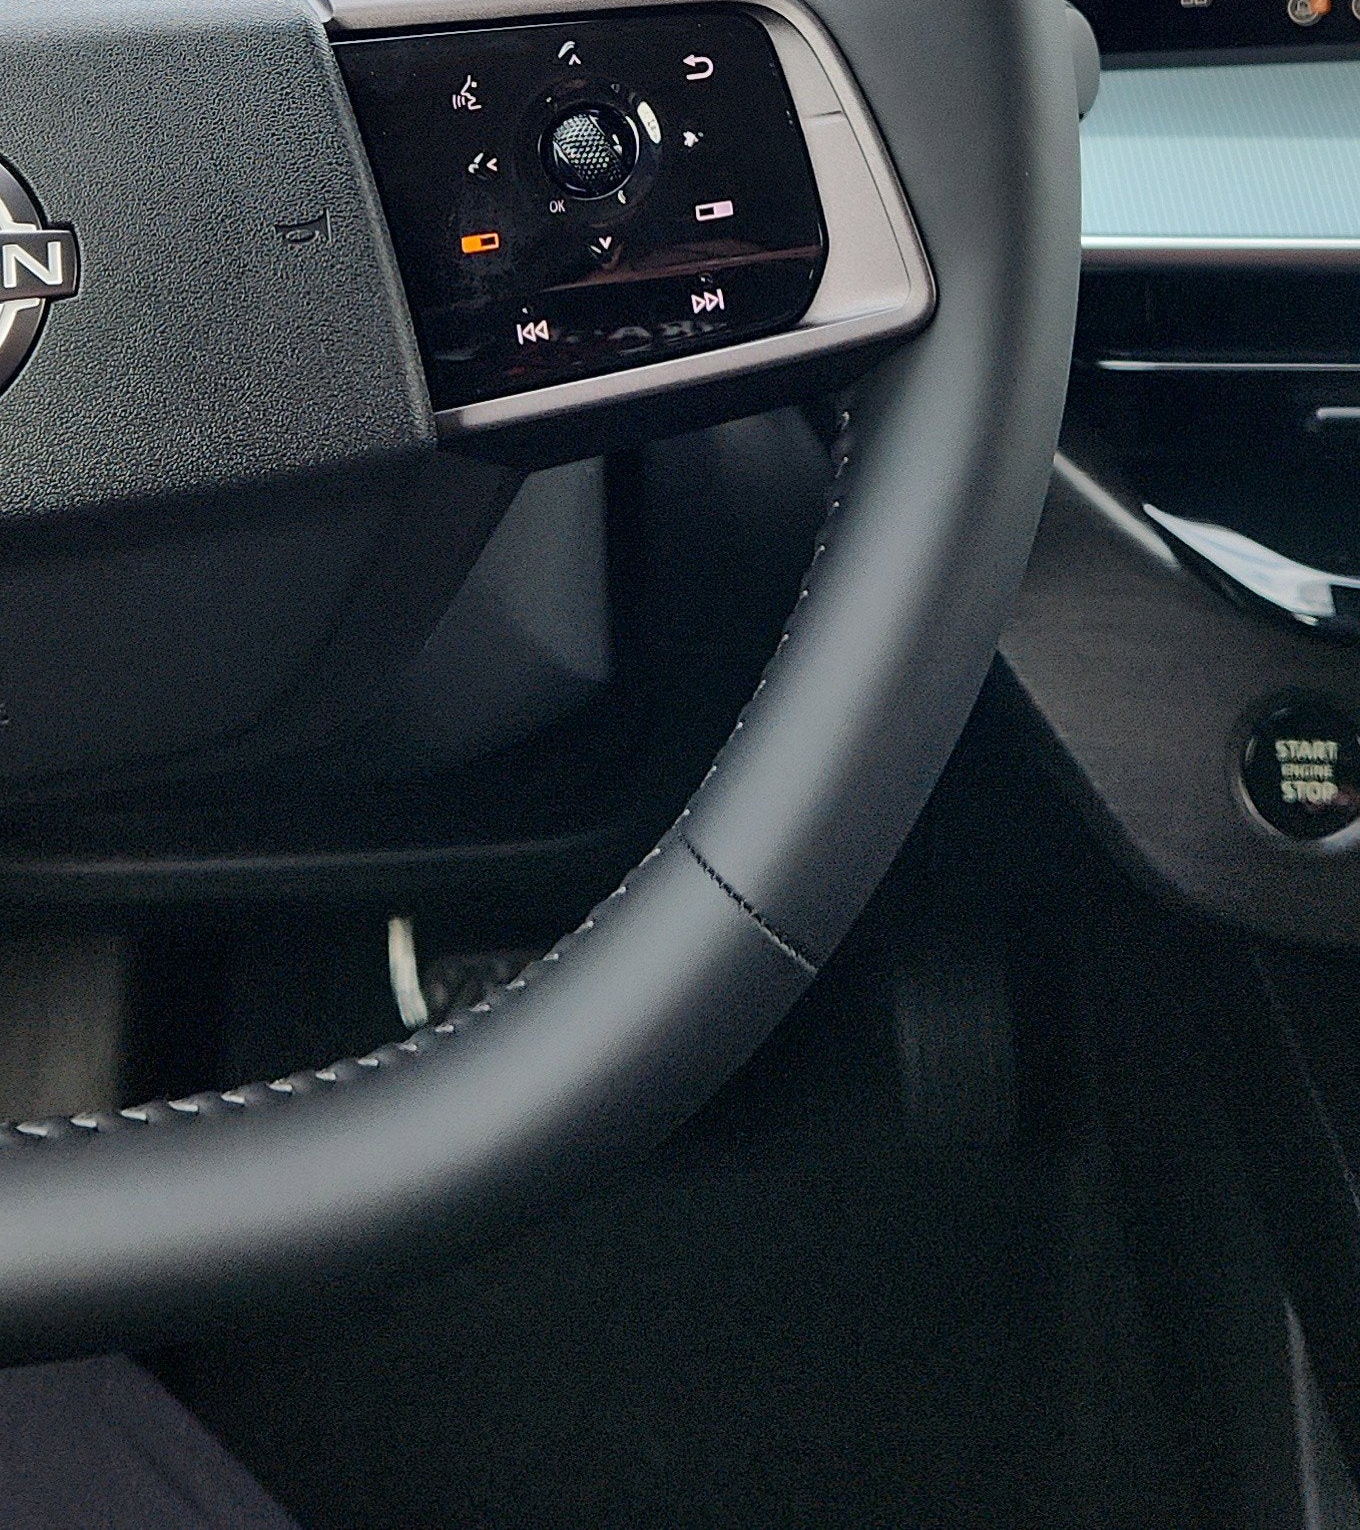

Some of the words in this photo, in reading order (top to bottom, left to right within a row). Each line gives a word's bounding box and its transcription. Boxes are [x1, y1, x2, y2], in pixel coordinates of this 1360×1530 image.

[549, 199, 566, 214] OK
[1274, 739, 1338, 761] START
[1281, 763, 1333, 779] ENGINE
[1281, 780, 1339, 805] STOP
